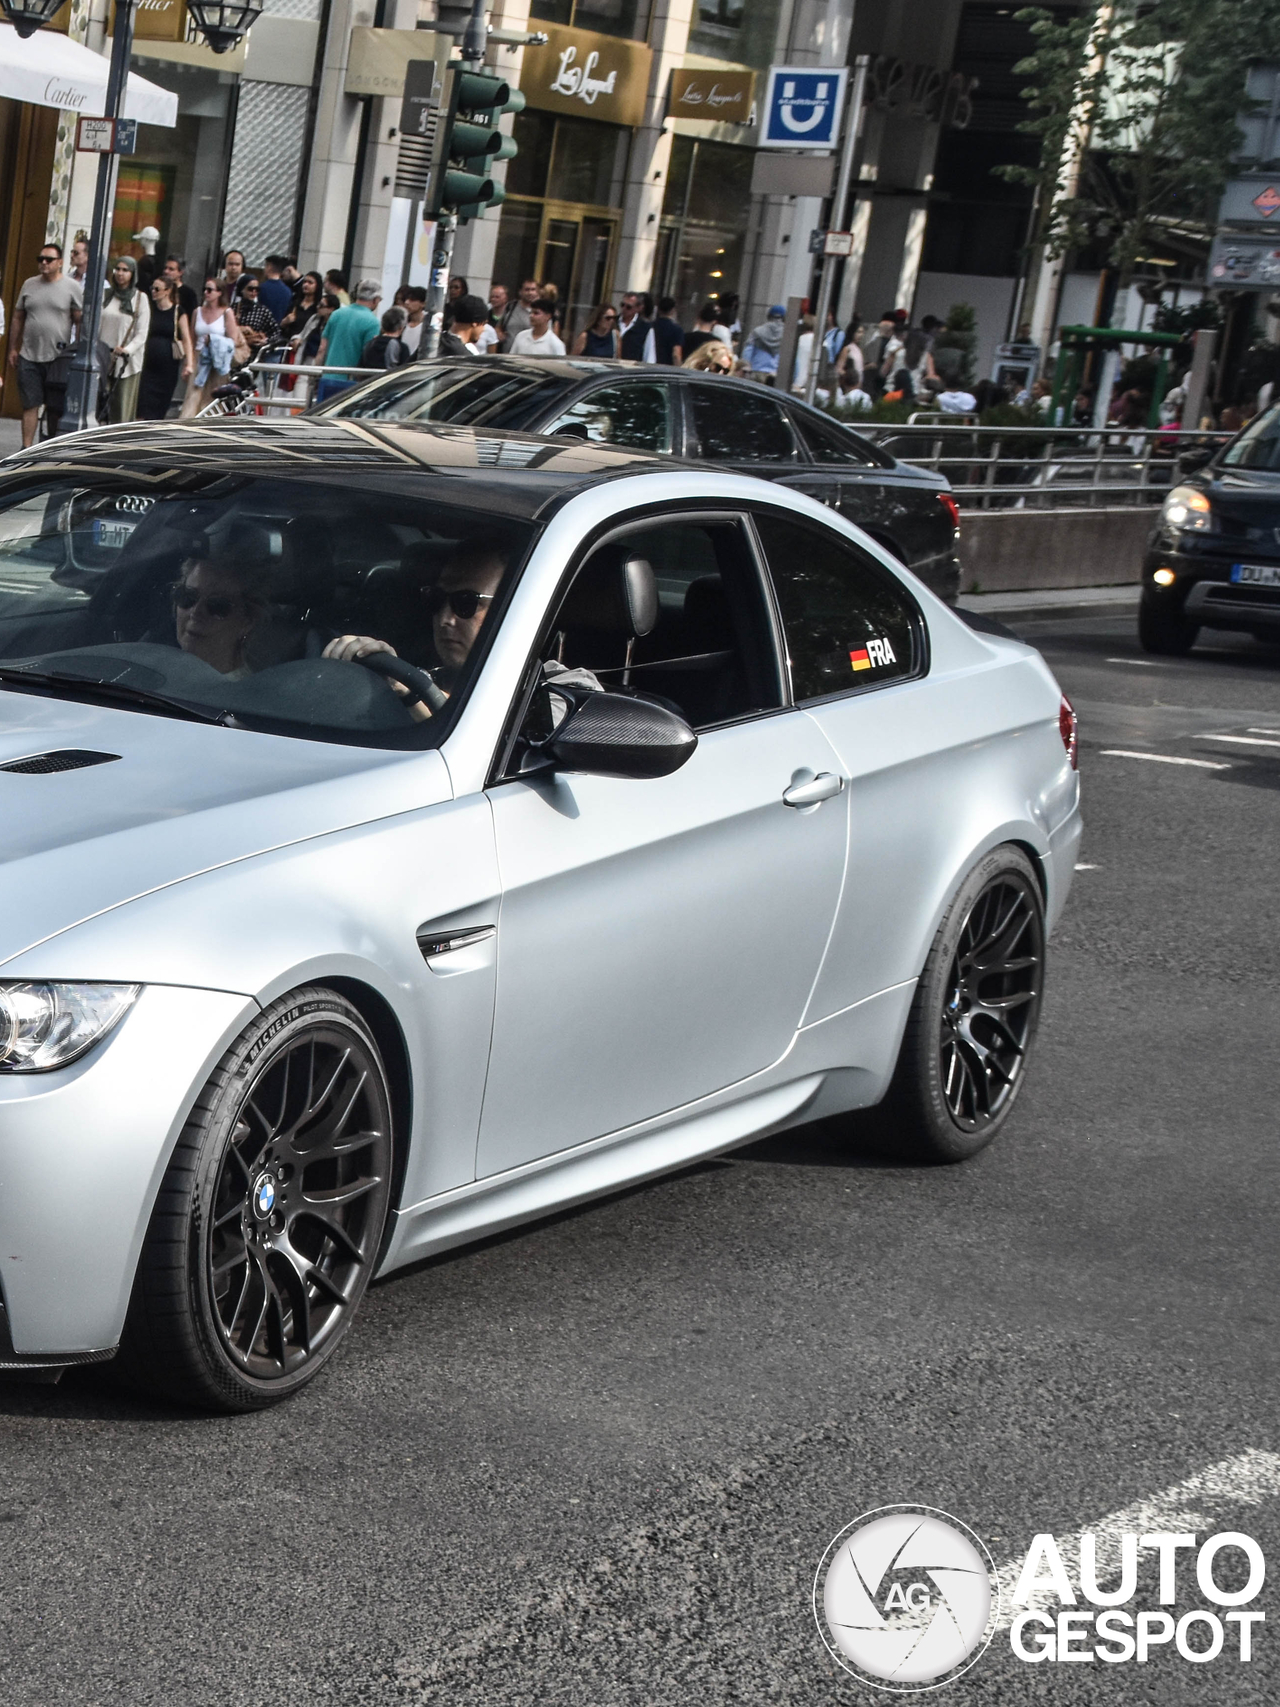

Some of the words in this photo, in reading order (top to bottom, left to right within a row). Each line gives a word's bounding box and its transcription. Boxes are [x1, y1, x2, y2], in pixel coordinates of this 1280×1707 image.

[43, 76, 87, 108] Cartier
[866, 637, 897, 668] FRA
[250, 1008, 300, 1061] MICHELIN
